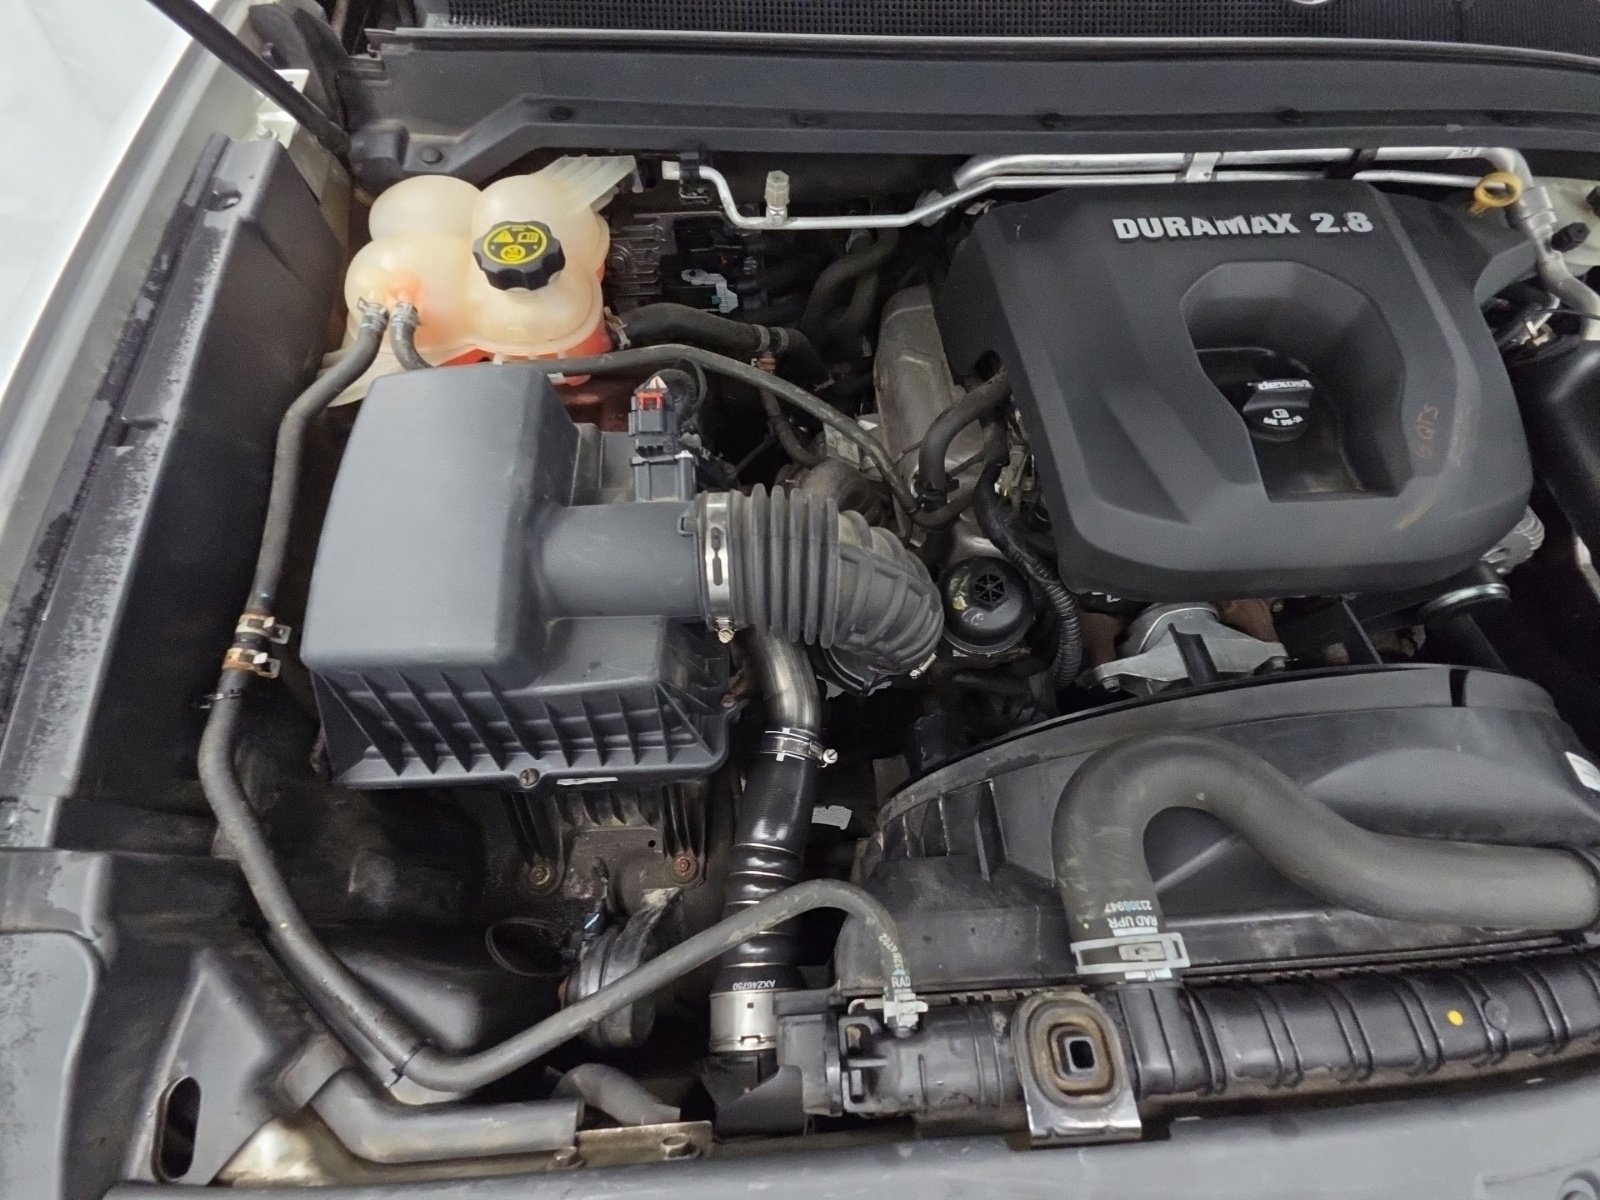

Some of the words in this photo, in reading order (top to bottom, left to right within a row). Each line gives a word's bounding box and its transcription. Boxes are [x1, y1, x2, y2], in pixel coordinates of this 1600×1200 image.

[1112, 213, 1301, 240] DURAMAX
[1309, 211, 1374, 234] 2.8
[1107, 916, 1135, 929] UPR
[1135, 915, 1158, 927] RAD
[891, 976, 911, 988] RAD
